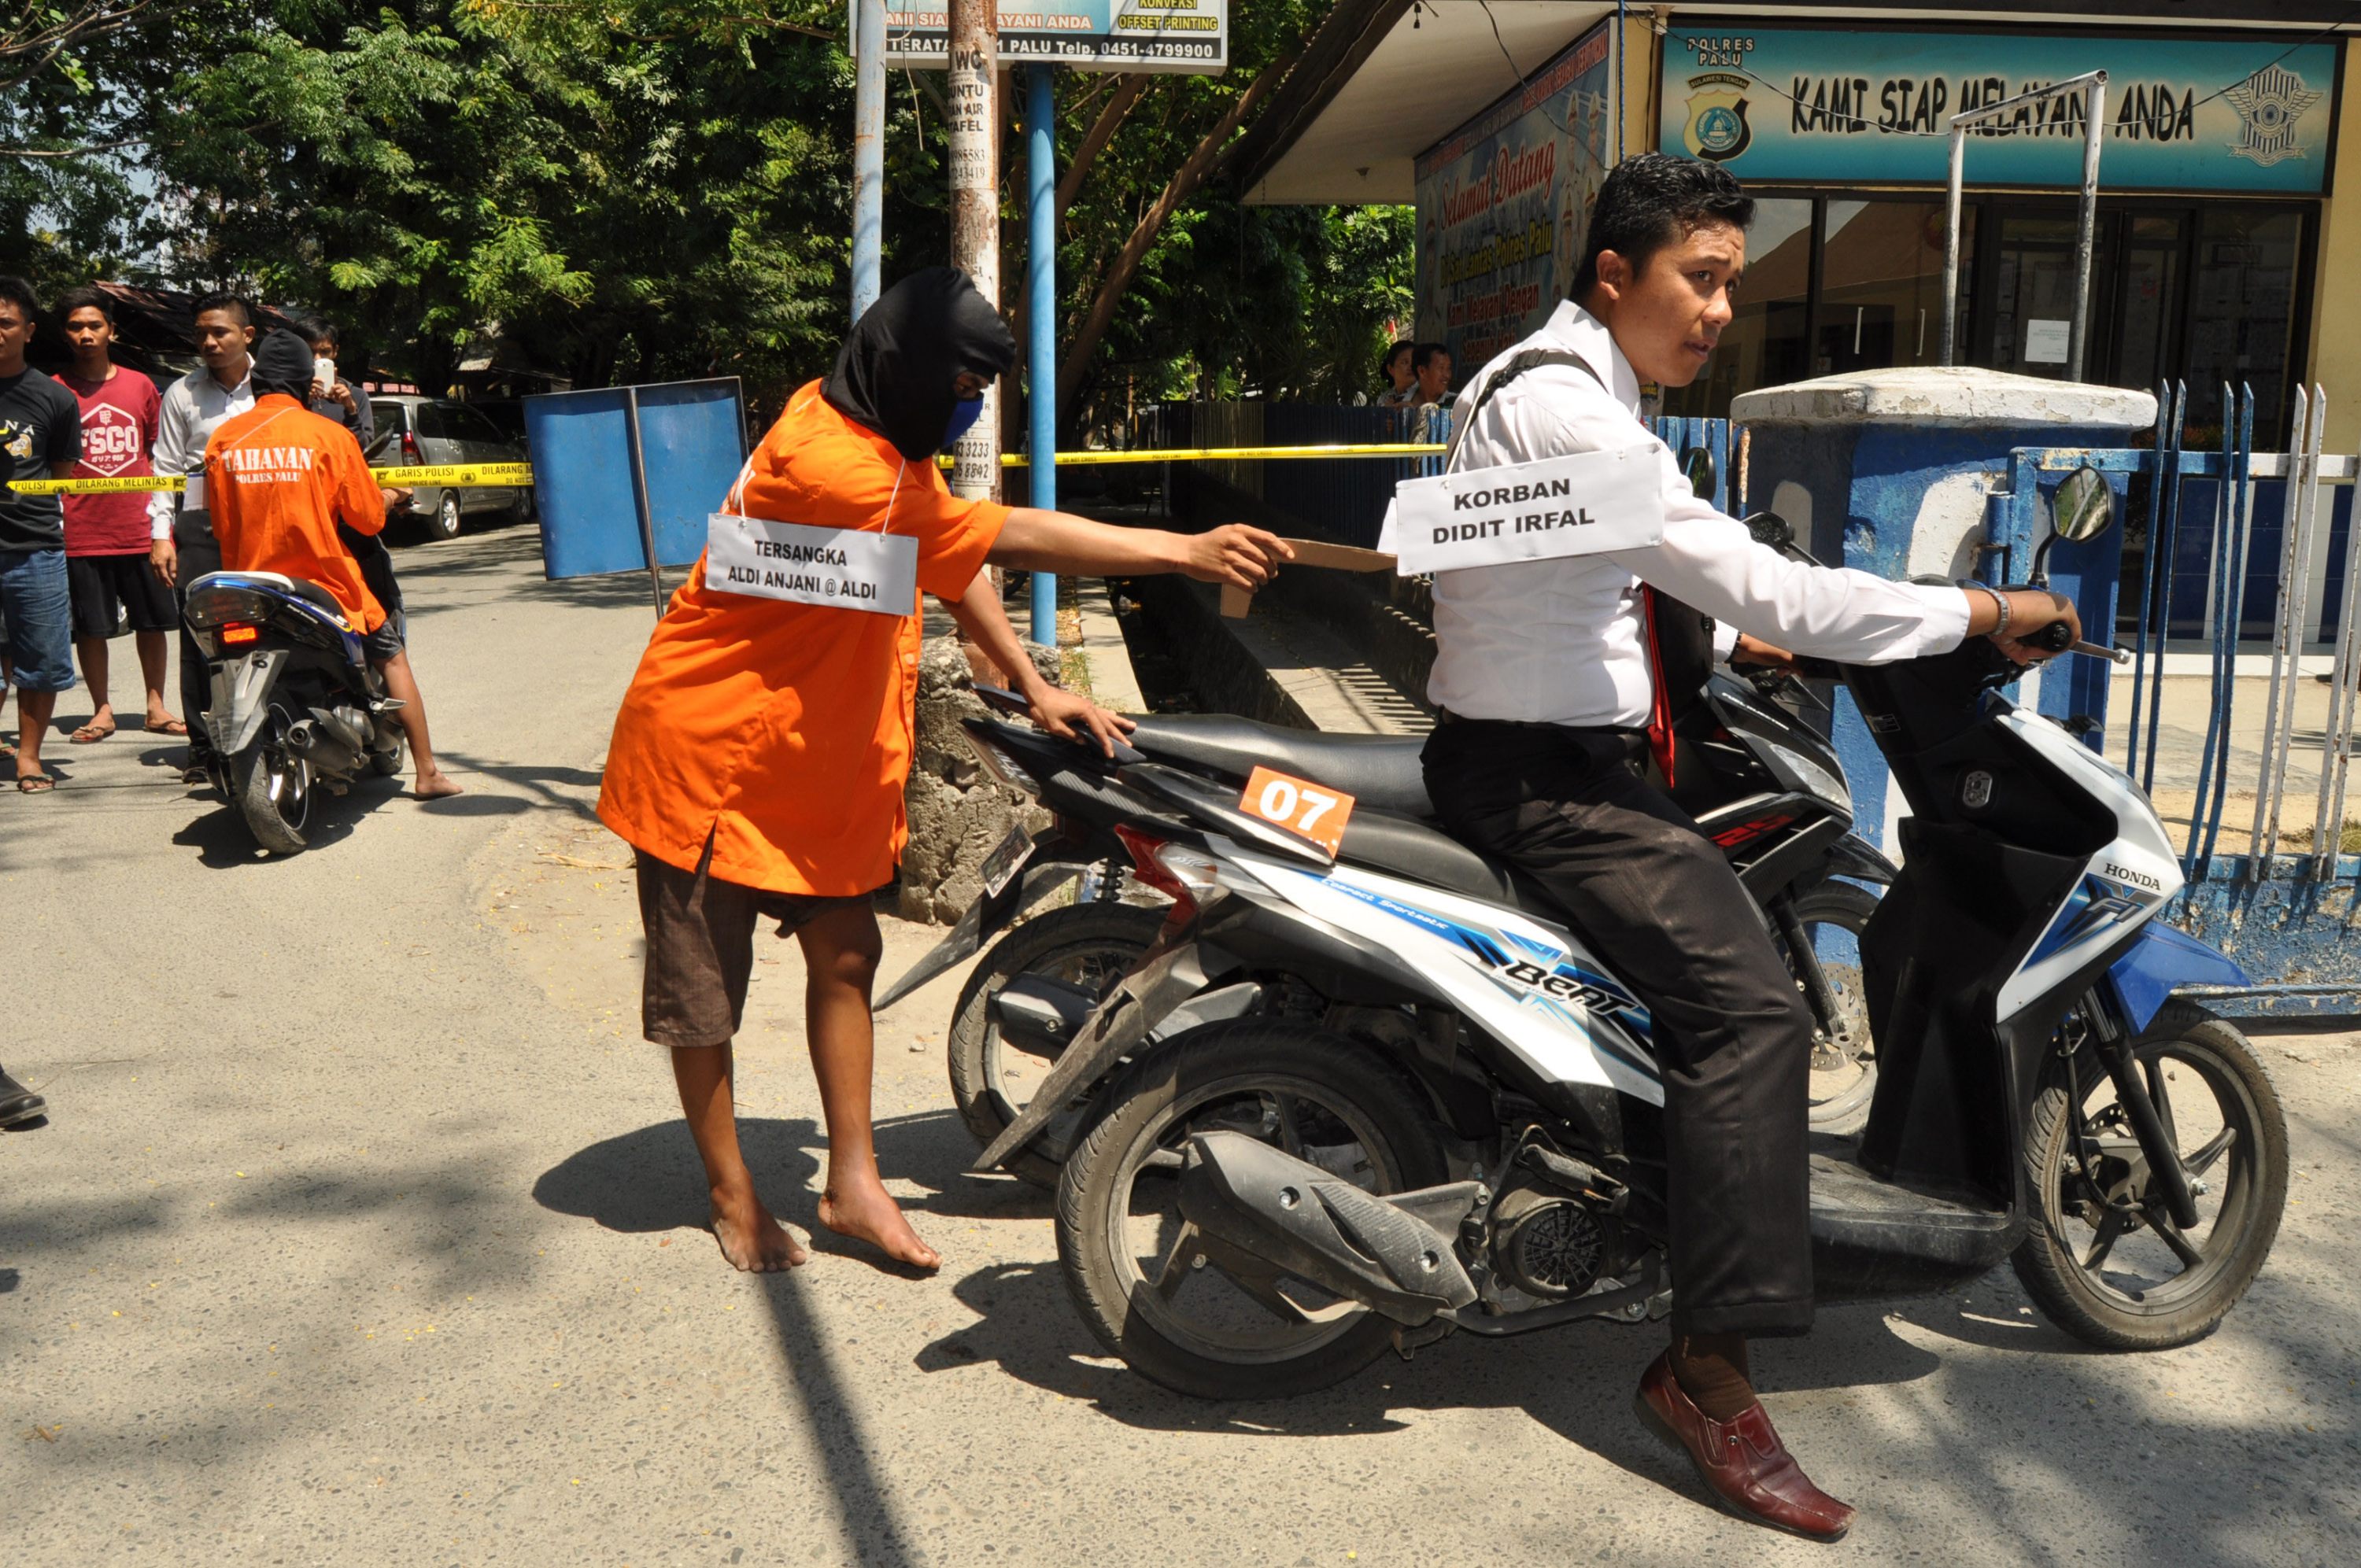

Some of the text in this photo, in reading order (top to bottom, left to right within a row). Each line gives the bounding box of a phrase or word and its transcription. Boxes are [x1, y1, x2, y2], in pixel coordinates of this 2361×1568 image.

[885, 12, 1093, 30] AMI SIA AYANI ANDA
[1118, 14, 1218, 31] OFFSET PRINTING
[891, 38, 948, 52] TERATA
[1010, 39, 1051, 53] PALU
[1056, 41, 1096, 55] Telp.
[1101, 42, 1213, 57] 0451-4799900
[1687, 37, 1754, 51] POLRES
[1698, 52, 1742, 65] PALU
[949, 84, 984, 98] UNTU
[1792, 76, 1868, 134] KAMI
[1878, 77, 1947, 133] SIAP
[1958, 77, 2107, 138] MELAYAN
[2115, 83, 2193, 142] ANDA
[949, 120, 984, 133] TAFEL
[1441, 165, 1491, 231] Selamat
[1495, 140, 1555, 205] Datang
[1495, 228, 1525, 270] Polres
[1528, 214, 1552, 261] Palu
[1504, 283, 1539, 321] Dengan
[221, 447, 314, 471] TAHANAN
[15, 477, 168, 490] POLISI DILARANG MELINTAS
[235, 472, 273, 484] POLRES
[395, 468, 423, 478] GARIS
[426, 467, 454, 477] POLISI
[482, 465, 523, 475] DILARANG
[1454, 478, 1570, 511] KORBAN
[1433, 508, 1595, 544] DIDIT IRFAL
[756, 540, 847, 566] TERSANGKA
[728, 566, 876, 600] ALDI ANJANI @ ALDI
[1260, 780, 1337, 831] 07
[2104, 863, 2161, 891] HONDA
